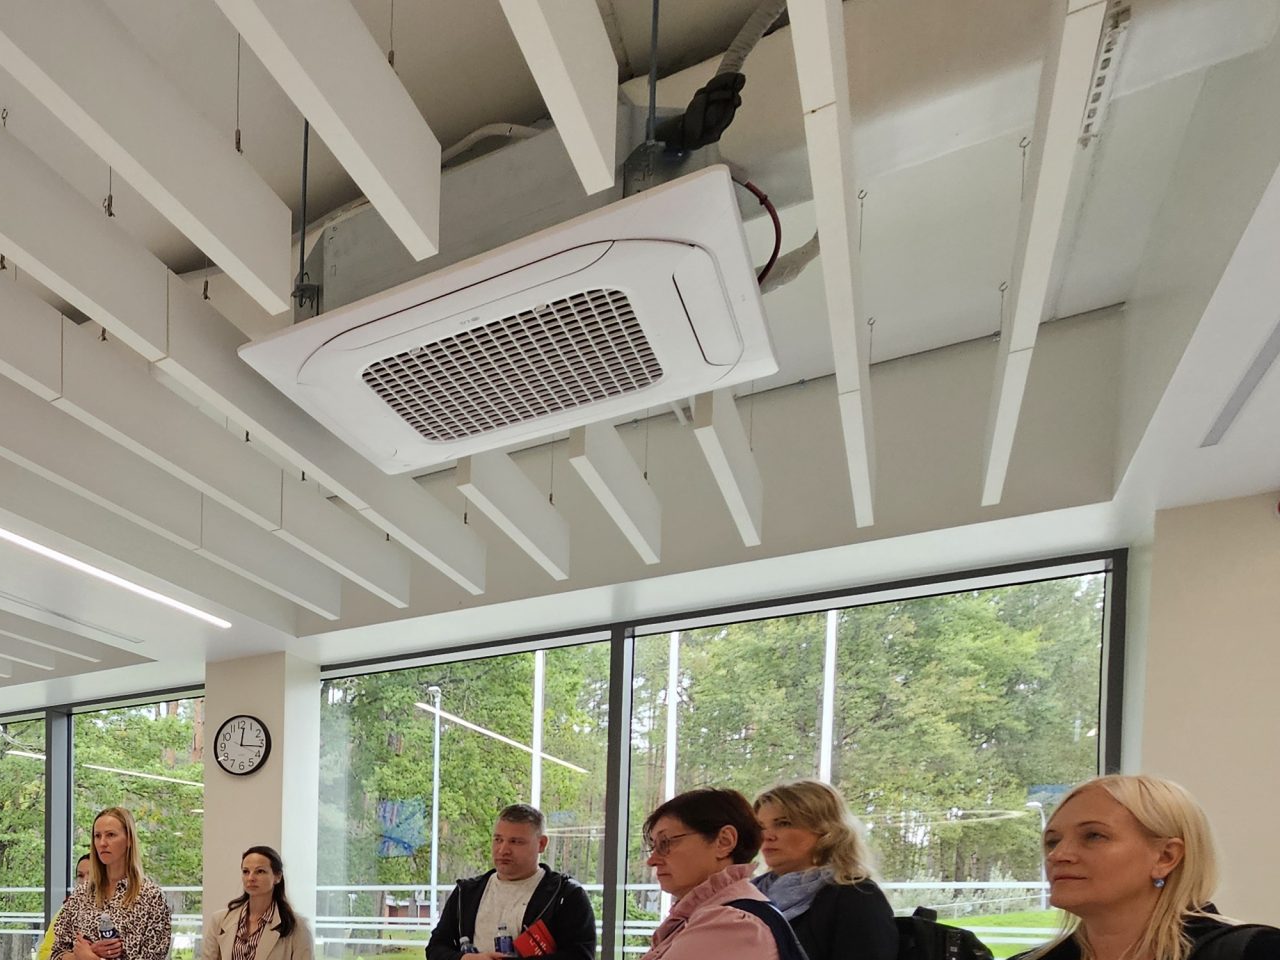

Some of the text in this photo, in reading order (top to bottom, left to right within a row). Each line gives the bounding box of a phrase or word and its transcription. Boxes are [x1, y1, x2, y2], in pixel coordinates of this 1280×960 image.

[230, 724, 236, 733] 11
[237, 720, 246, 730] 12
[222, 732, 231, 742] 10
[255, 728, 261, 738] 2
[220, 742, 226, 752] 9
[222, 752, 229, 761] 8
[255, 749, 261, 758] 4
[230, 758, 236, 768] 7
[238, 761, 245, 770] 6
[248, 758, 255, 767] 5
